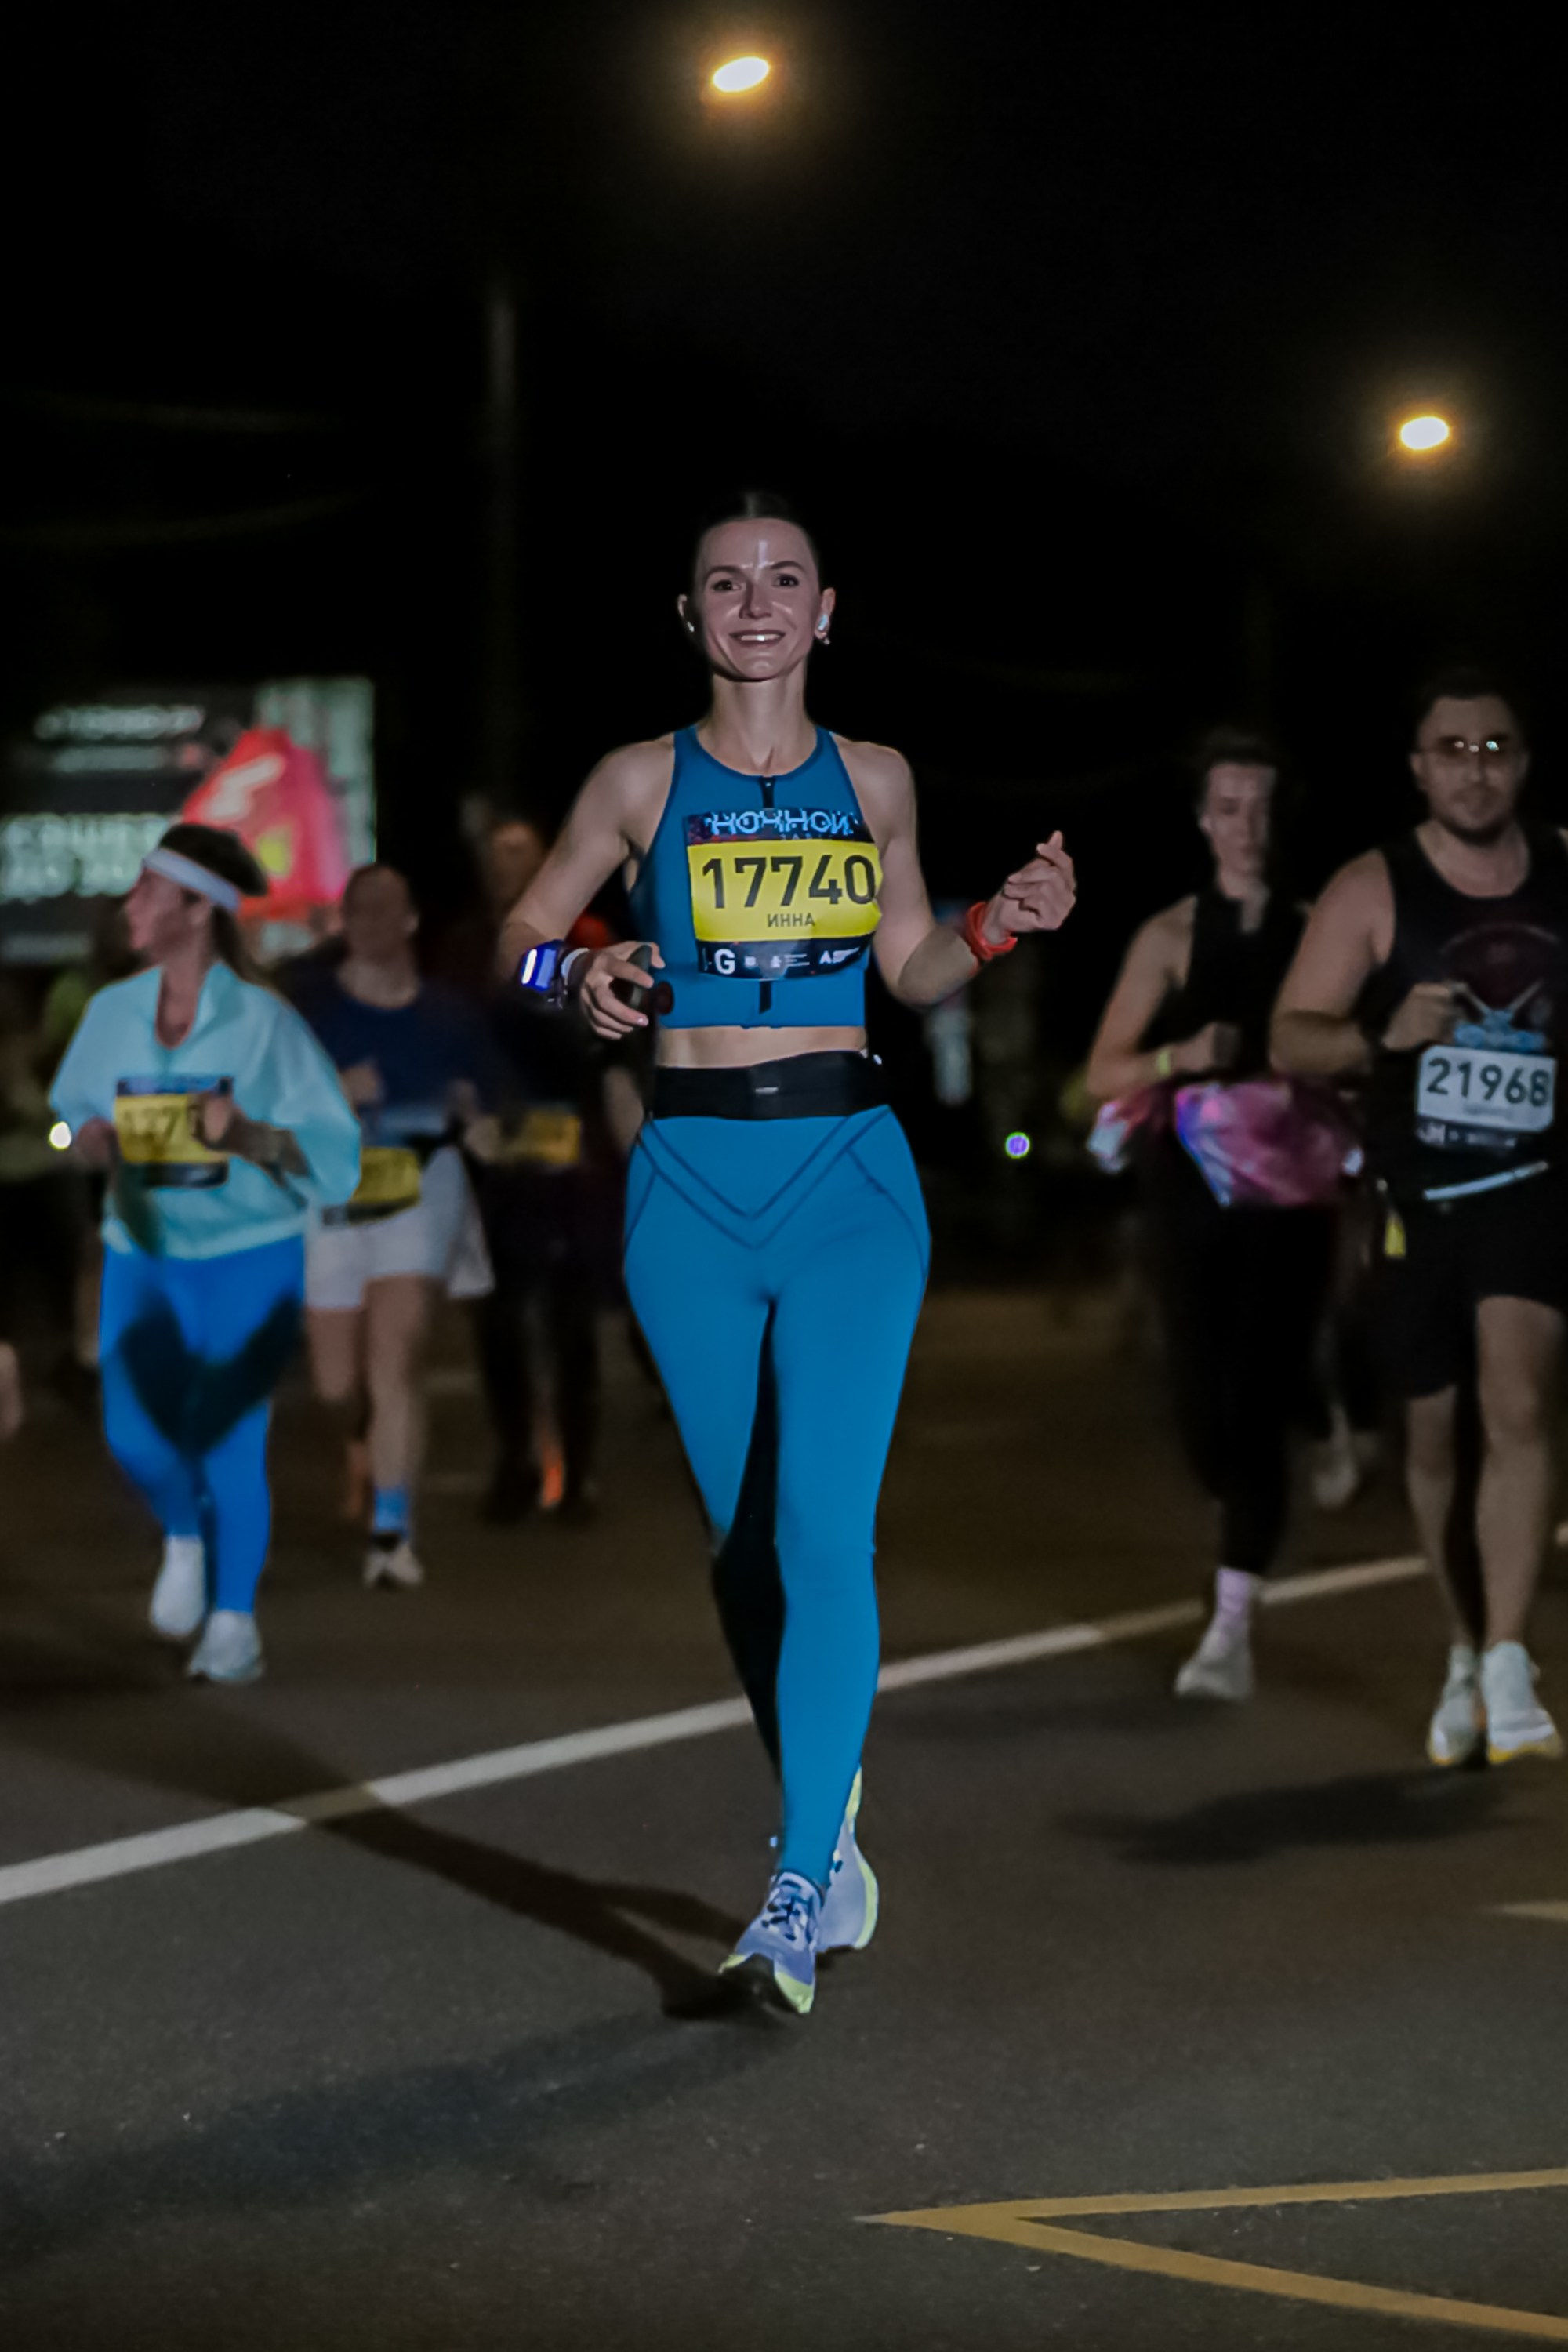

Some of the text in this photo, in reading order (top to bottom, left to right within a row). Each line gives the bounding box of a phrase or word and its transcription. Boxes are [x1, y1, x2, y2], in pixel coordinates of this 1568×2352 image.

[709, 808, 854, 837] НОЧНОЙ
[702, 854, 877, 909] 17740
[768, 913, 815, 928] ИННА
[714, 949, 735, 975] G
[1426, 1057, 1550, 1108] 21968
